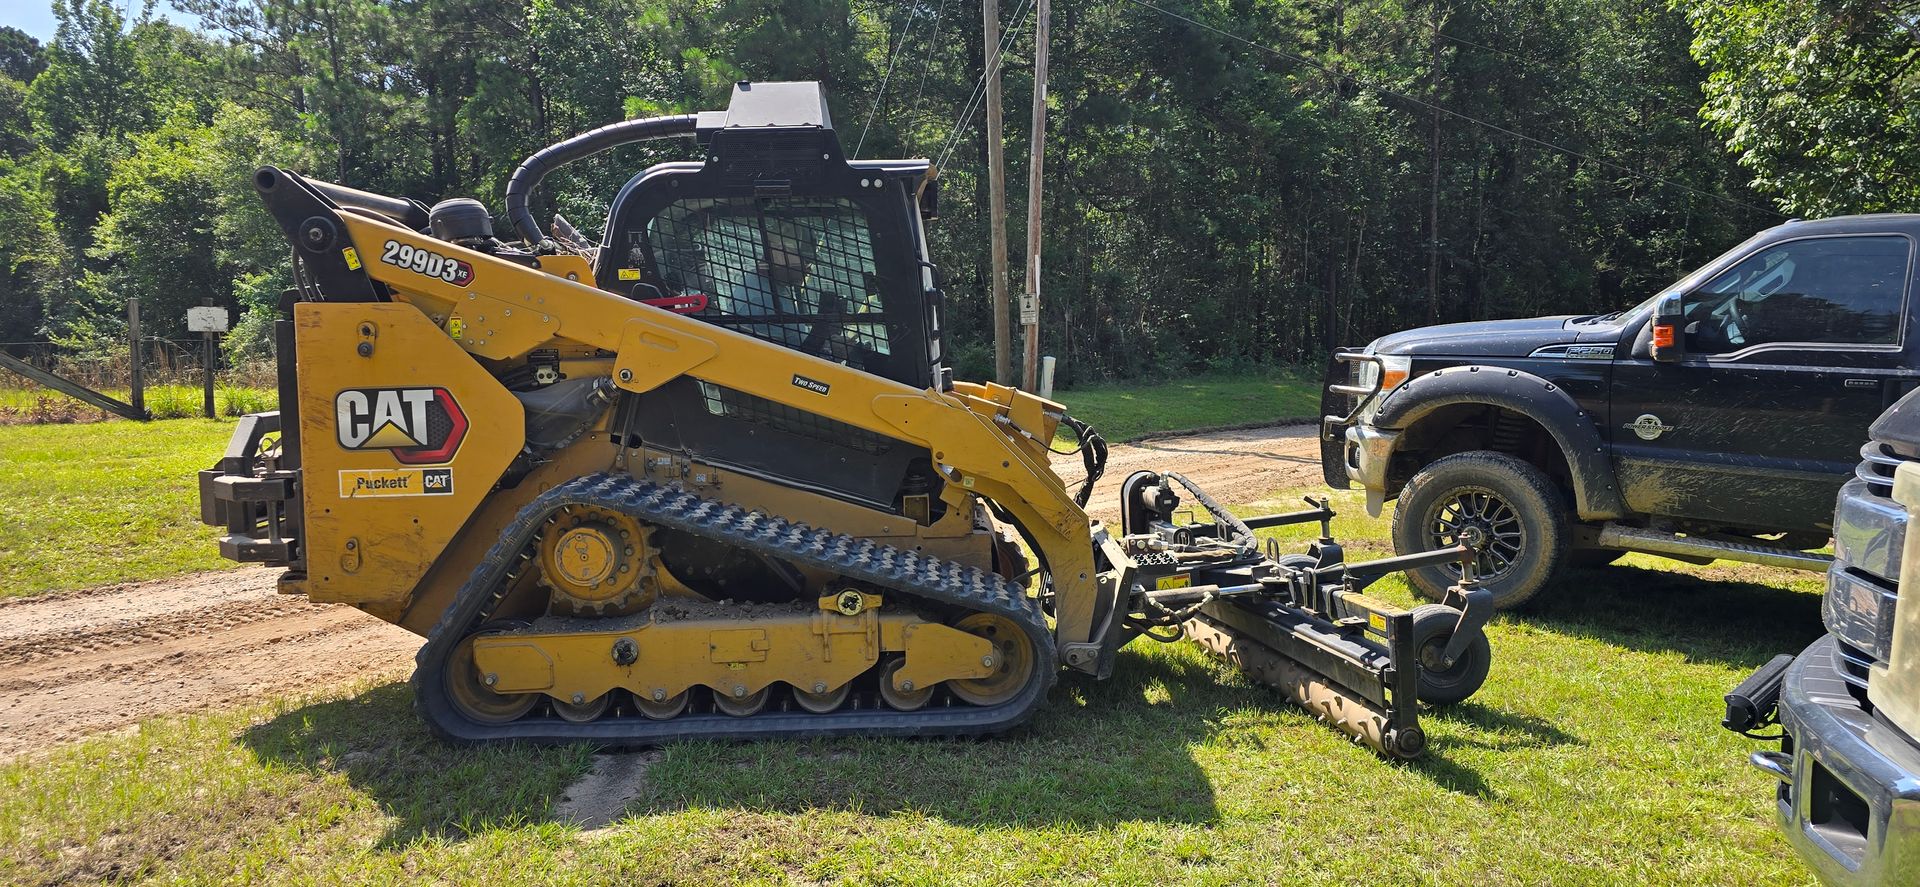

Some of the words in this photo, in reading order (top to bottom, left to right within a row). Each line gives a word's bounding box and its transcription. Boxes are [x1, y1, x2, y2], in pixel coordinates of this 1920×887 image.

[382, 240, 458, 282] 299D3
[457, 269, 468, 279] XE
[337, 389, 434, 447] CAT
[357, 477, 408, 489] Puckett
[425, 475, 449, 488] CAT
